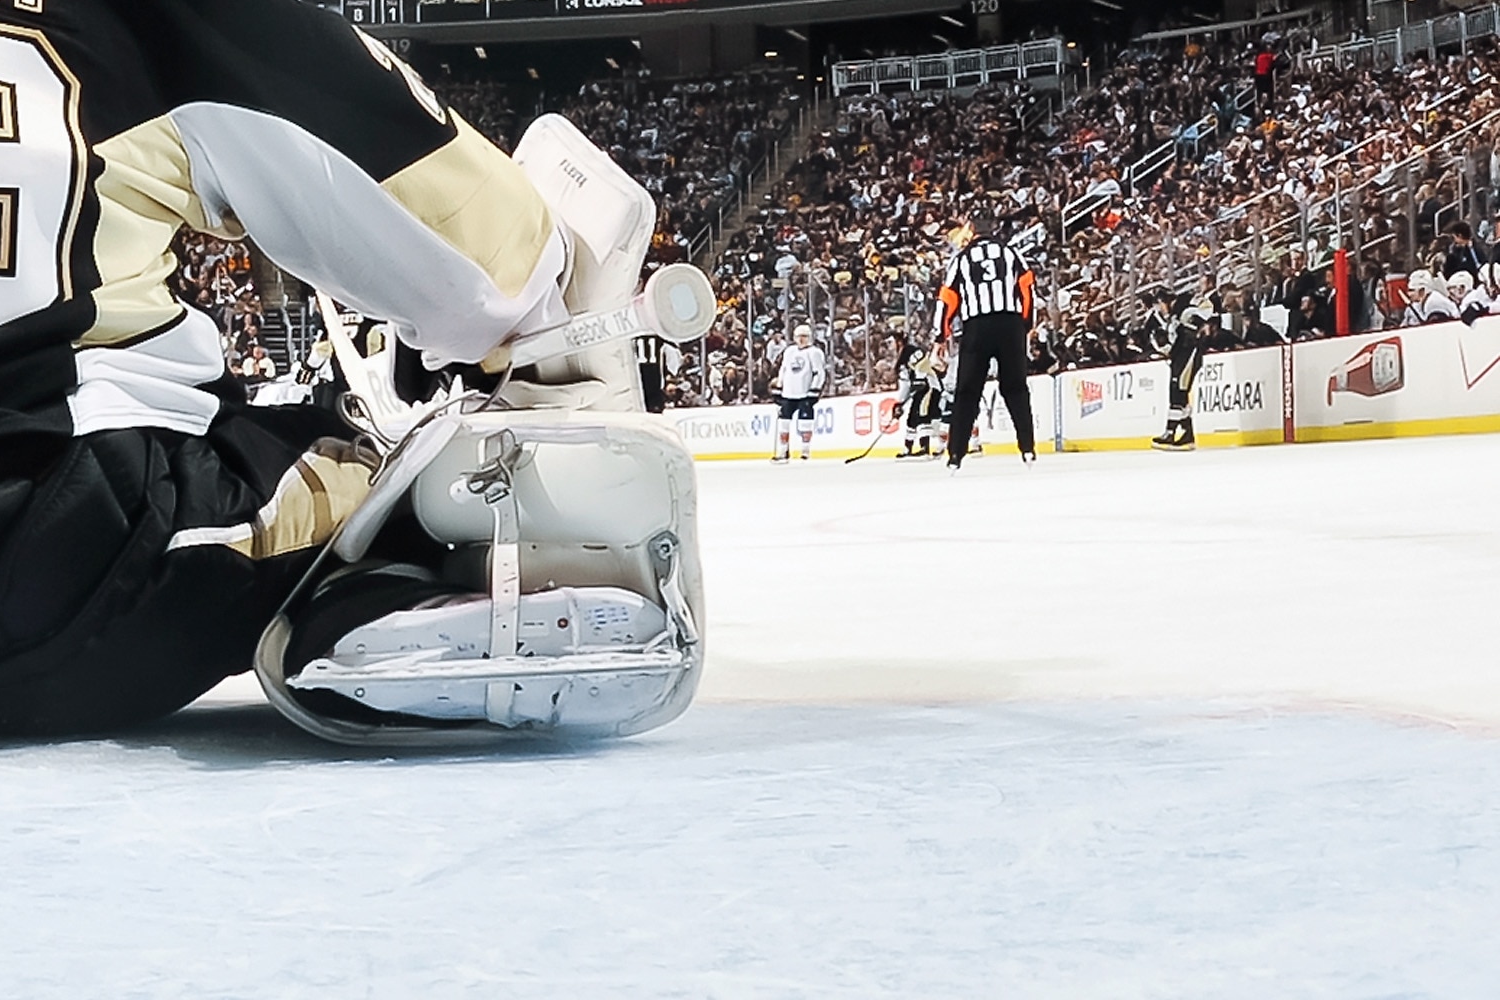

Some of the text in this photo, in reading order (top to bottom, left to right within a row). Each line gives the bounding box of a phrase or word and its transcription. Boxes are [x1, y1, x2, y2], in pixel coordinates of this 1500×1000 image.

[980, 259, 998, 281] 3
[636, 337, 657, 364] 11
[1197, 382, 1264, 414] NIAGARA
